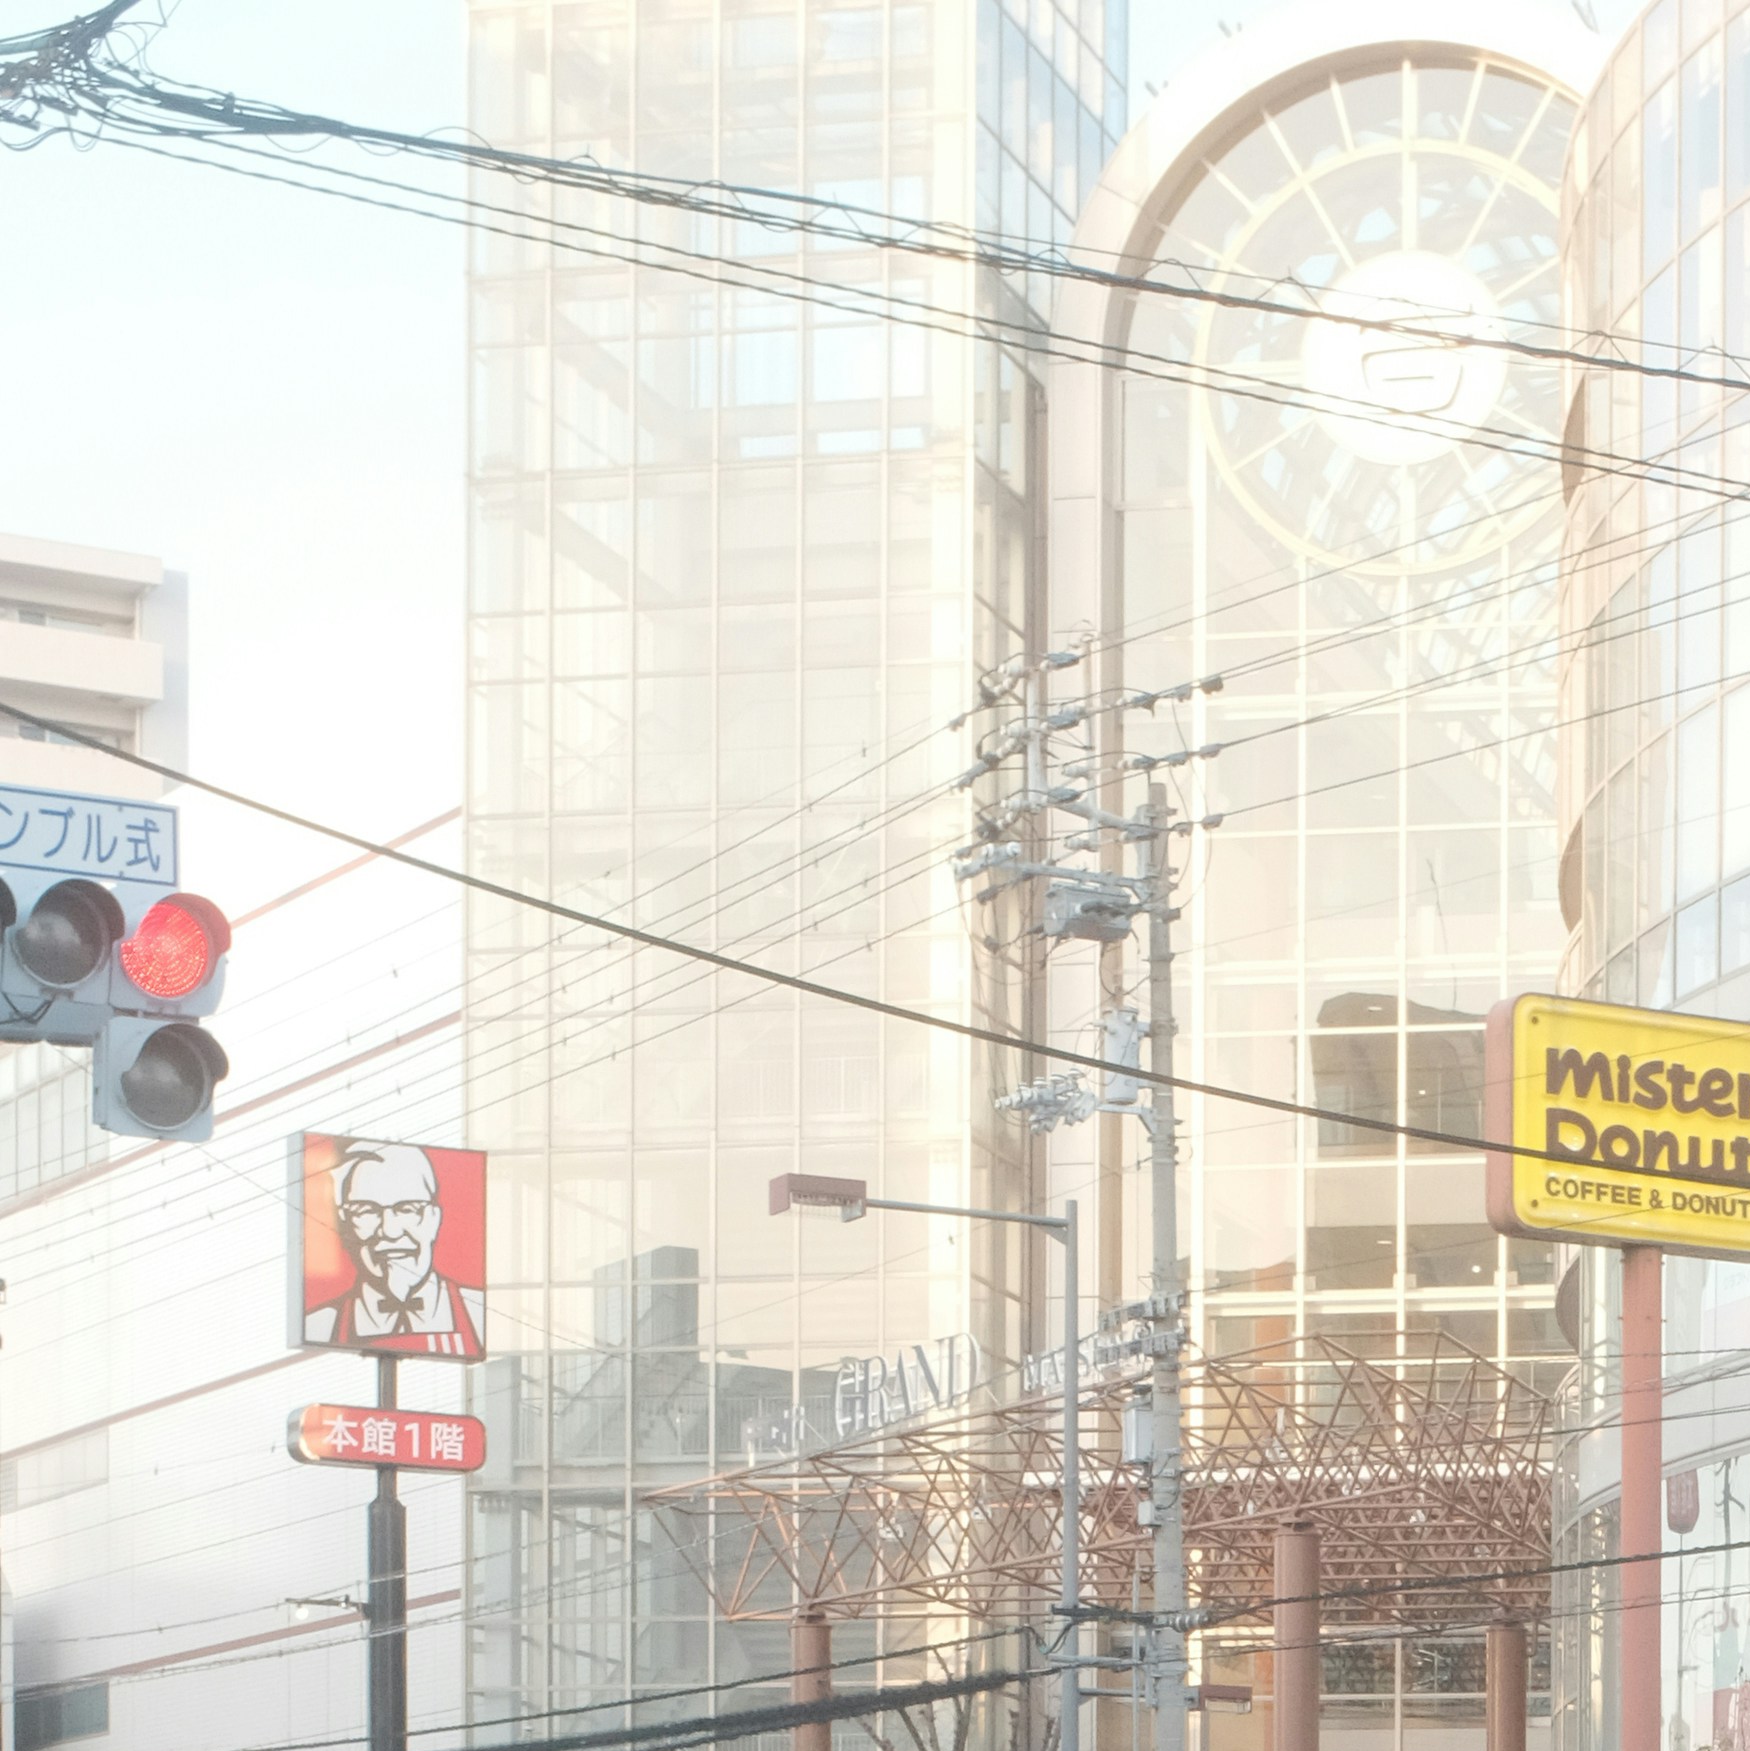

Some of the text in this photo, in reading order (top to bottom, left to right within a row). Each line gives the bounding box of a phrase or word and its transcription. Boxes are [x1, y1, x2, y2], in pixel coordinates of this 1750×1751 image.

[1545, 1176, 1642, 1207] COFFEE
[1649, 1189, 1664, 1209] &
[321, 1413, 465, 1462] 本館1階
